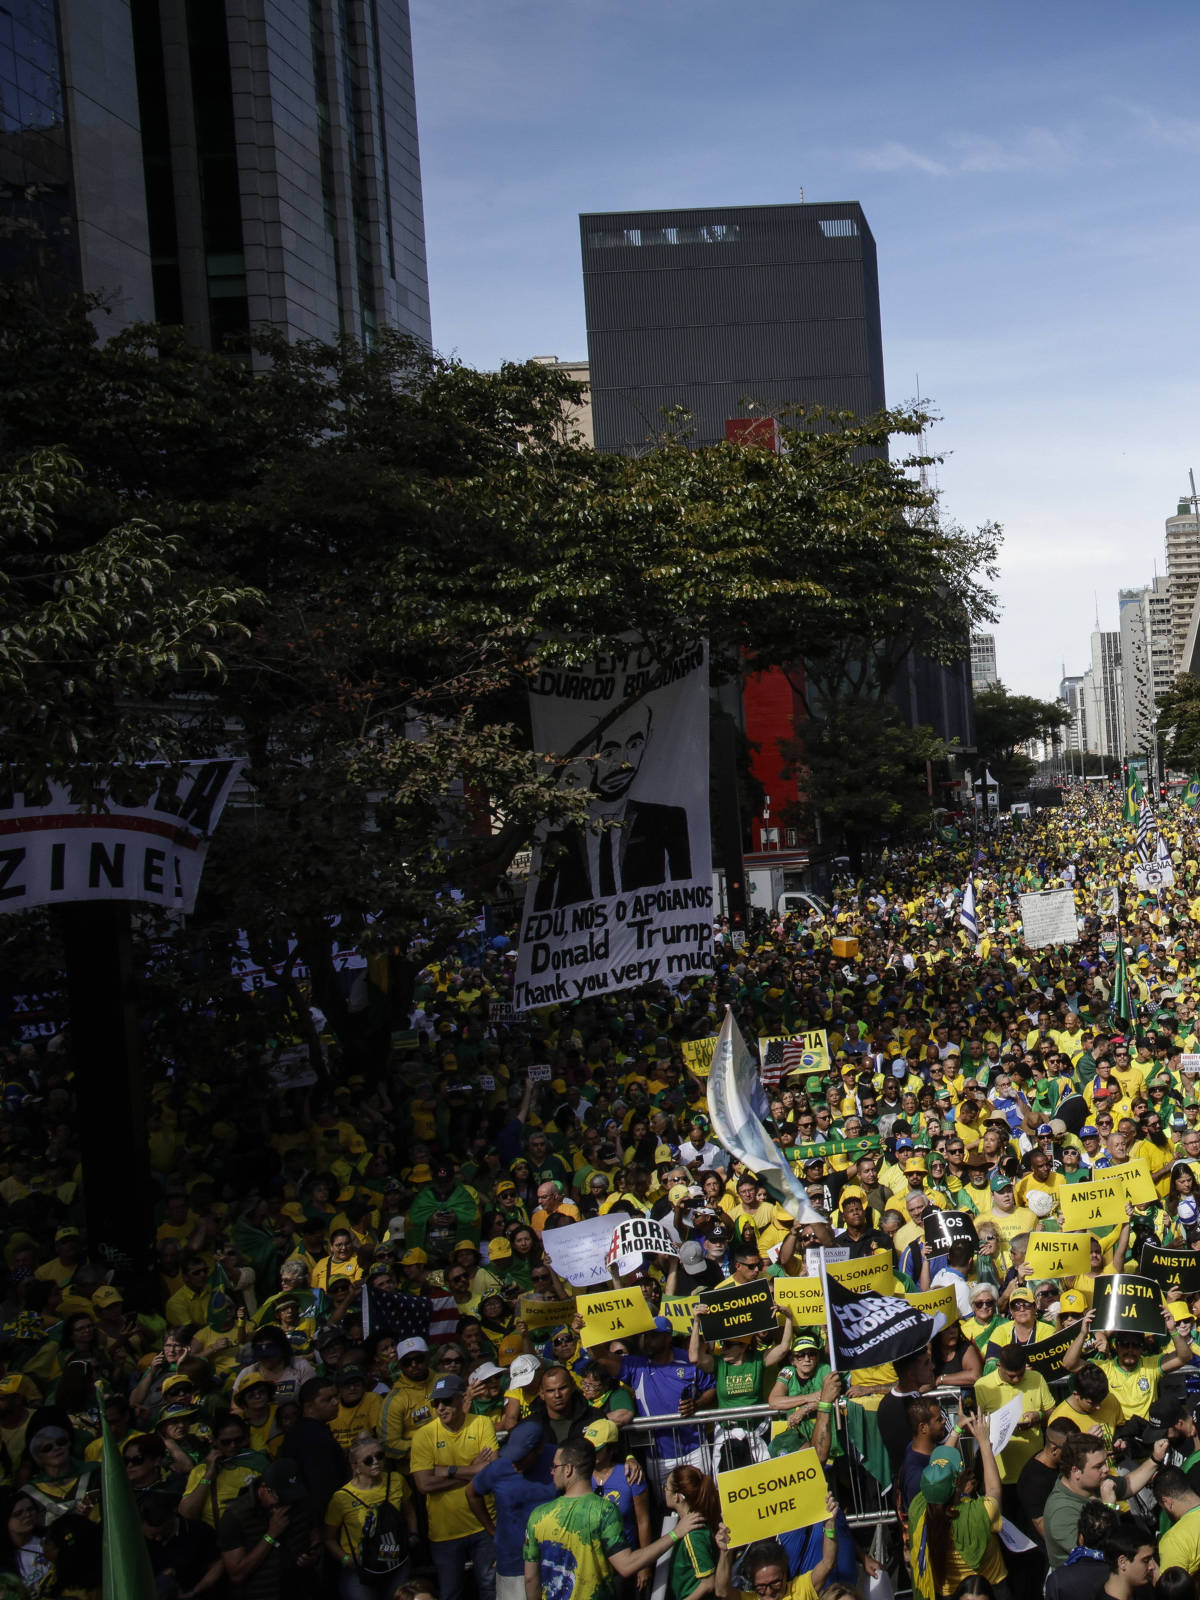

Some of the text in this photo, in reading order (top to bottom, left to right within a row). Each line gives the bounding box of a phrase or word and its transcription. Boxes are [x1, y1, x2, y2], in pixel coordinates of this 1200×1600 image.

[530, 671, 616, 701] EDUARDO
[572, 902, 609, 933] NÓS
[616, 901, 627, 922] O
[531, 917, 712, 976] Donald Trump
[515, 973, 570, 1010] Thank
[572, 972, 609, 1000] you
[611, 957, 661, 985] very
[794, 1142, 848, 1161] RASIL
[1071, 1187, 1116, 1203] ANISTIA
[1088, 1206, 1102, 1220] JÁ
[619, 1220, 672, 1242] FORA
[621, 1237, 678, 1256] MORAES
[1034, 1241, 1079, 1252] ANISTIA
[1049, 1259, 1064, 1271] JÁ
[1152, 1254, 1197, 1267] ANISTIA
[832, 1264, 889, 1282] OLSONARO
[1166, 1272, 1181, 1284] JÁ
[779, 1290, 825, 1300] BOLSONA
[1104, 1283, 1154, 1299] ANISTIA
[586, 1297, 634, 1315] ANISTIA
[706, 1292, 768, 1315] BOLSONARO
[797, 1305, 824, 1314] LIVRE
[1120, 1303, 1138, 1318] JÁ
[610, 1317, 625, 1331] JÁ
[723, 1313, 753, 1328] LIVRE
[727, 1467, 817, 1504] BOLSONARO
[757, 1497, 797, 1520] LIVRE
